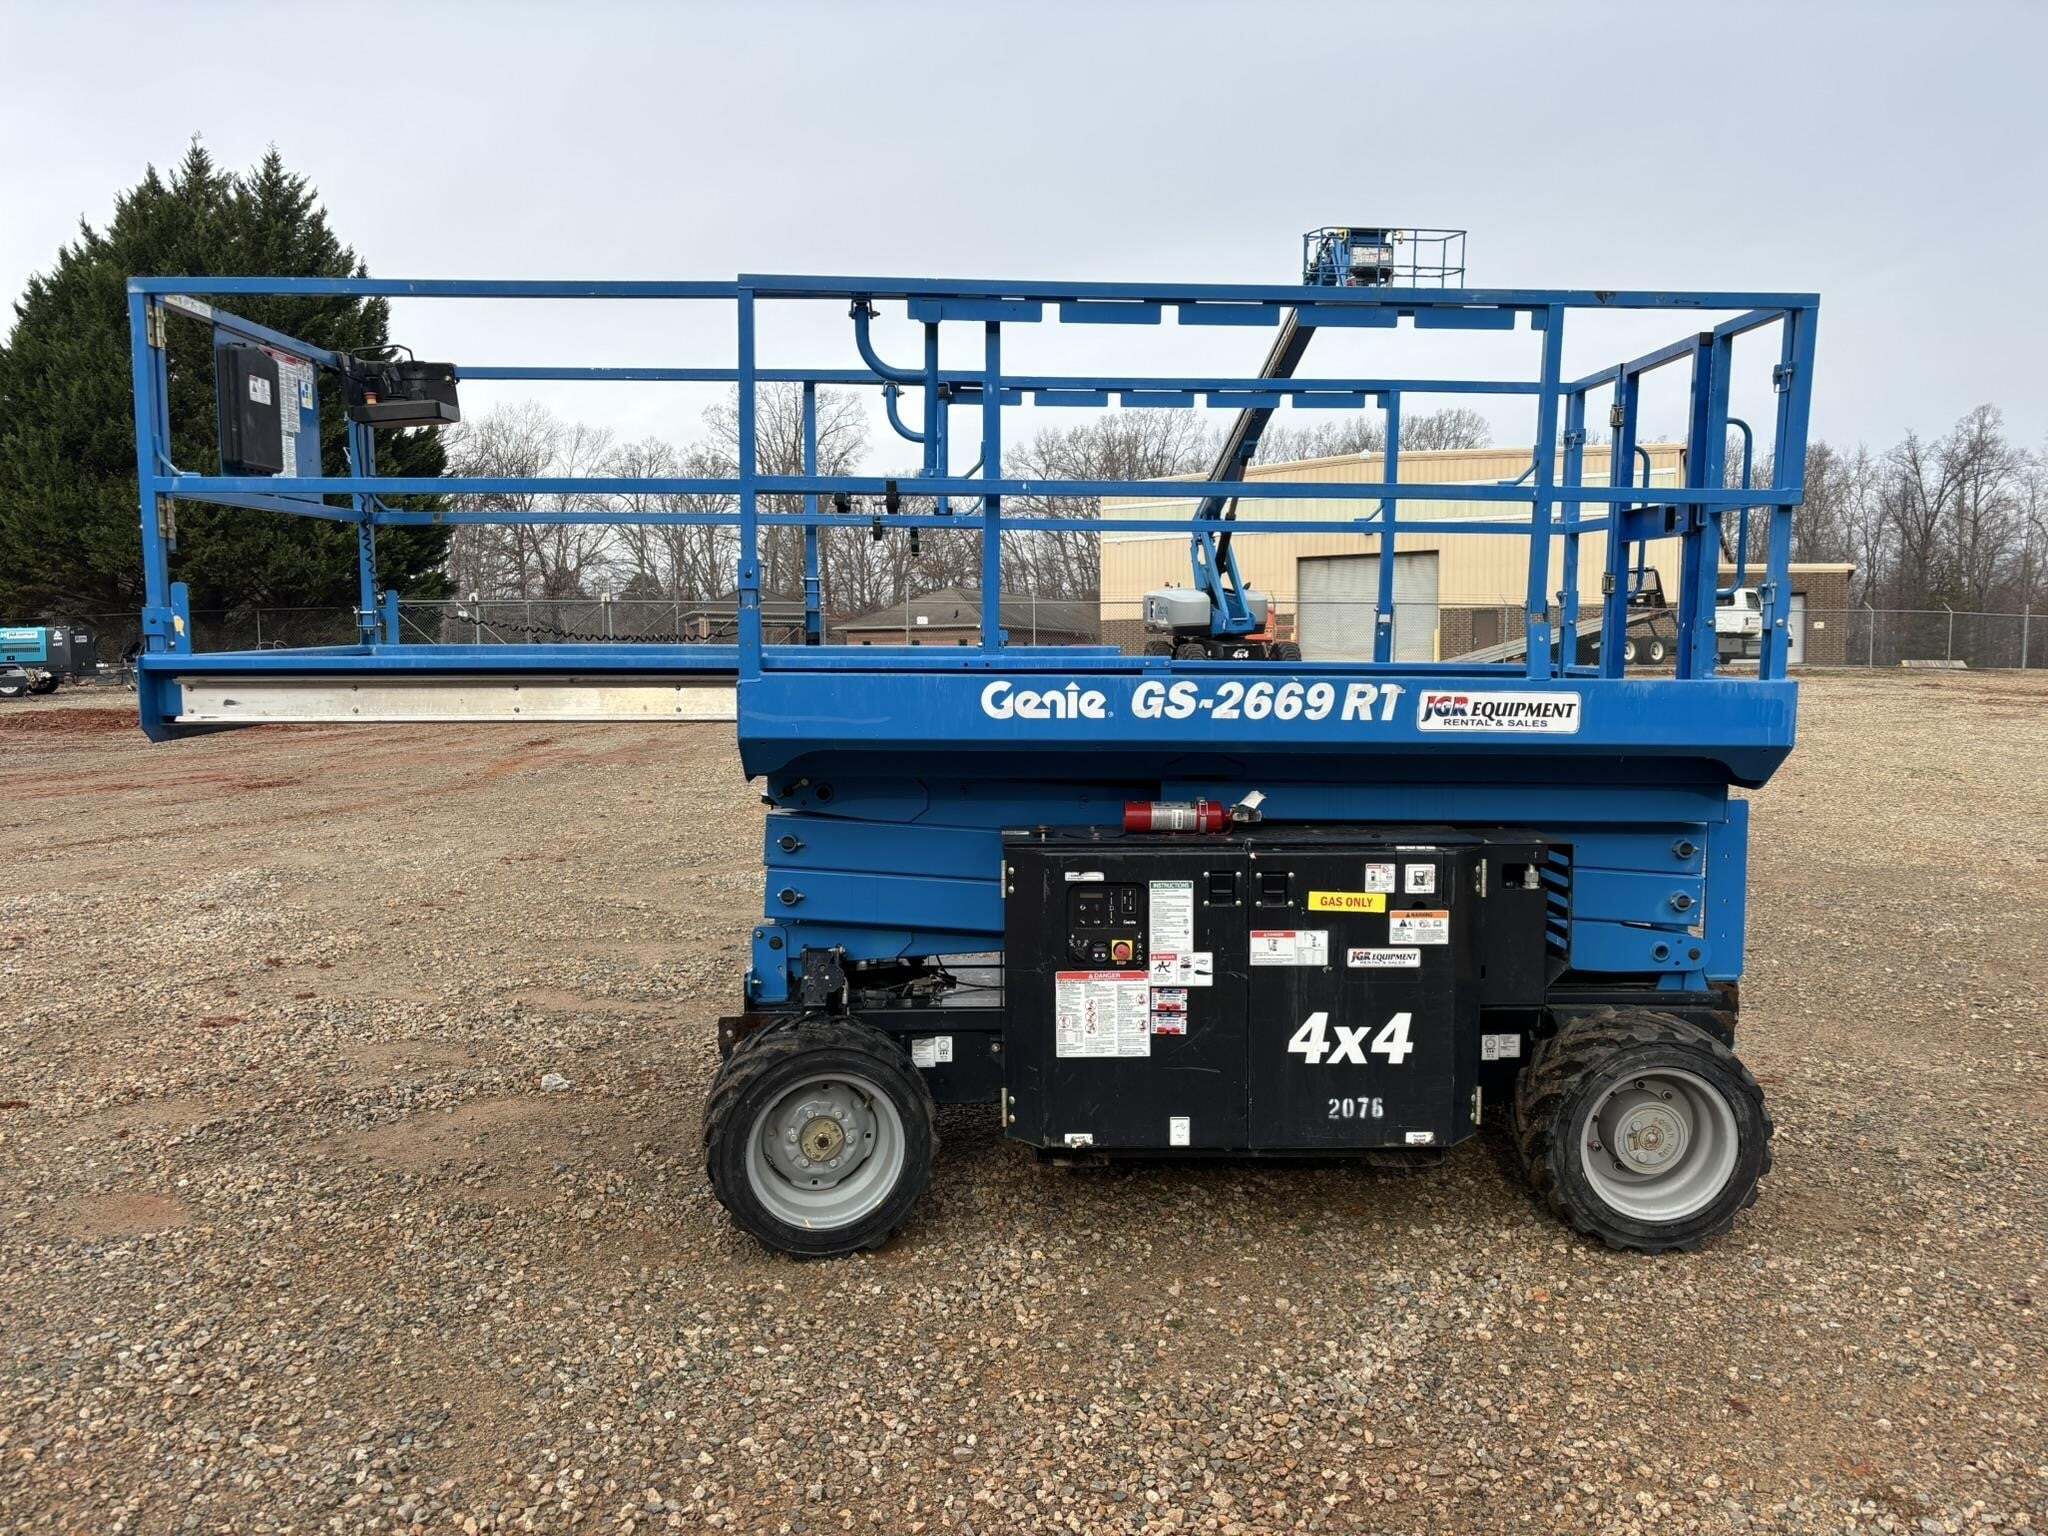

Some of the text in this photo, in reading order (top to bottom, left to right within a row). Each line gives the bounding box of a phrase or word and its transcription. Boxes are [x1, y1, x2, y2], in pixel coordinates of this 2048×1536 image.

[1232, 649, 1249, 658] 4x4
[980, 680, 1406, 721] Genie GS-2669 RT
[1421, 695, 1577, 722] JGR EQUIPMENT
[1443, 718, 1548, 728] RENTAL & SALES
[1320, 896, 1373, 907] GAS ONLY
[1351, 951, 1417, 963] JGR EQUIPMENT
[1093, 970, 1121, 979] DANGER
[1287, 1011, 1414, 1065] 4x4
[1328, 1097, 1384, 1120] 2076
